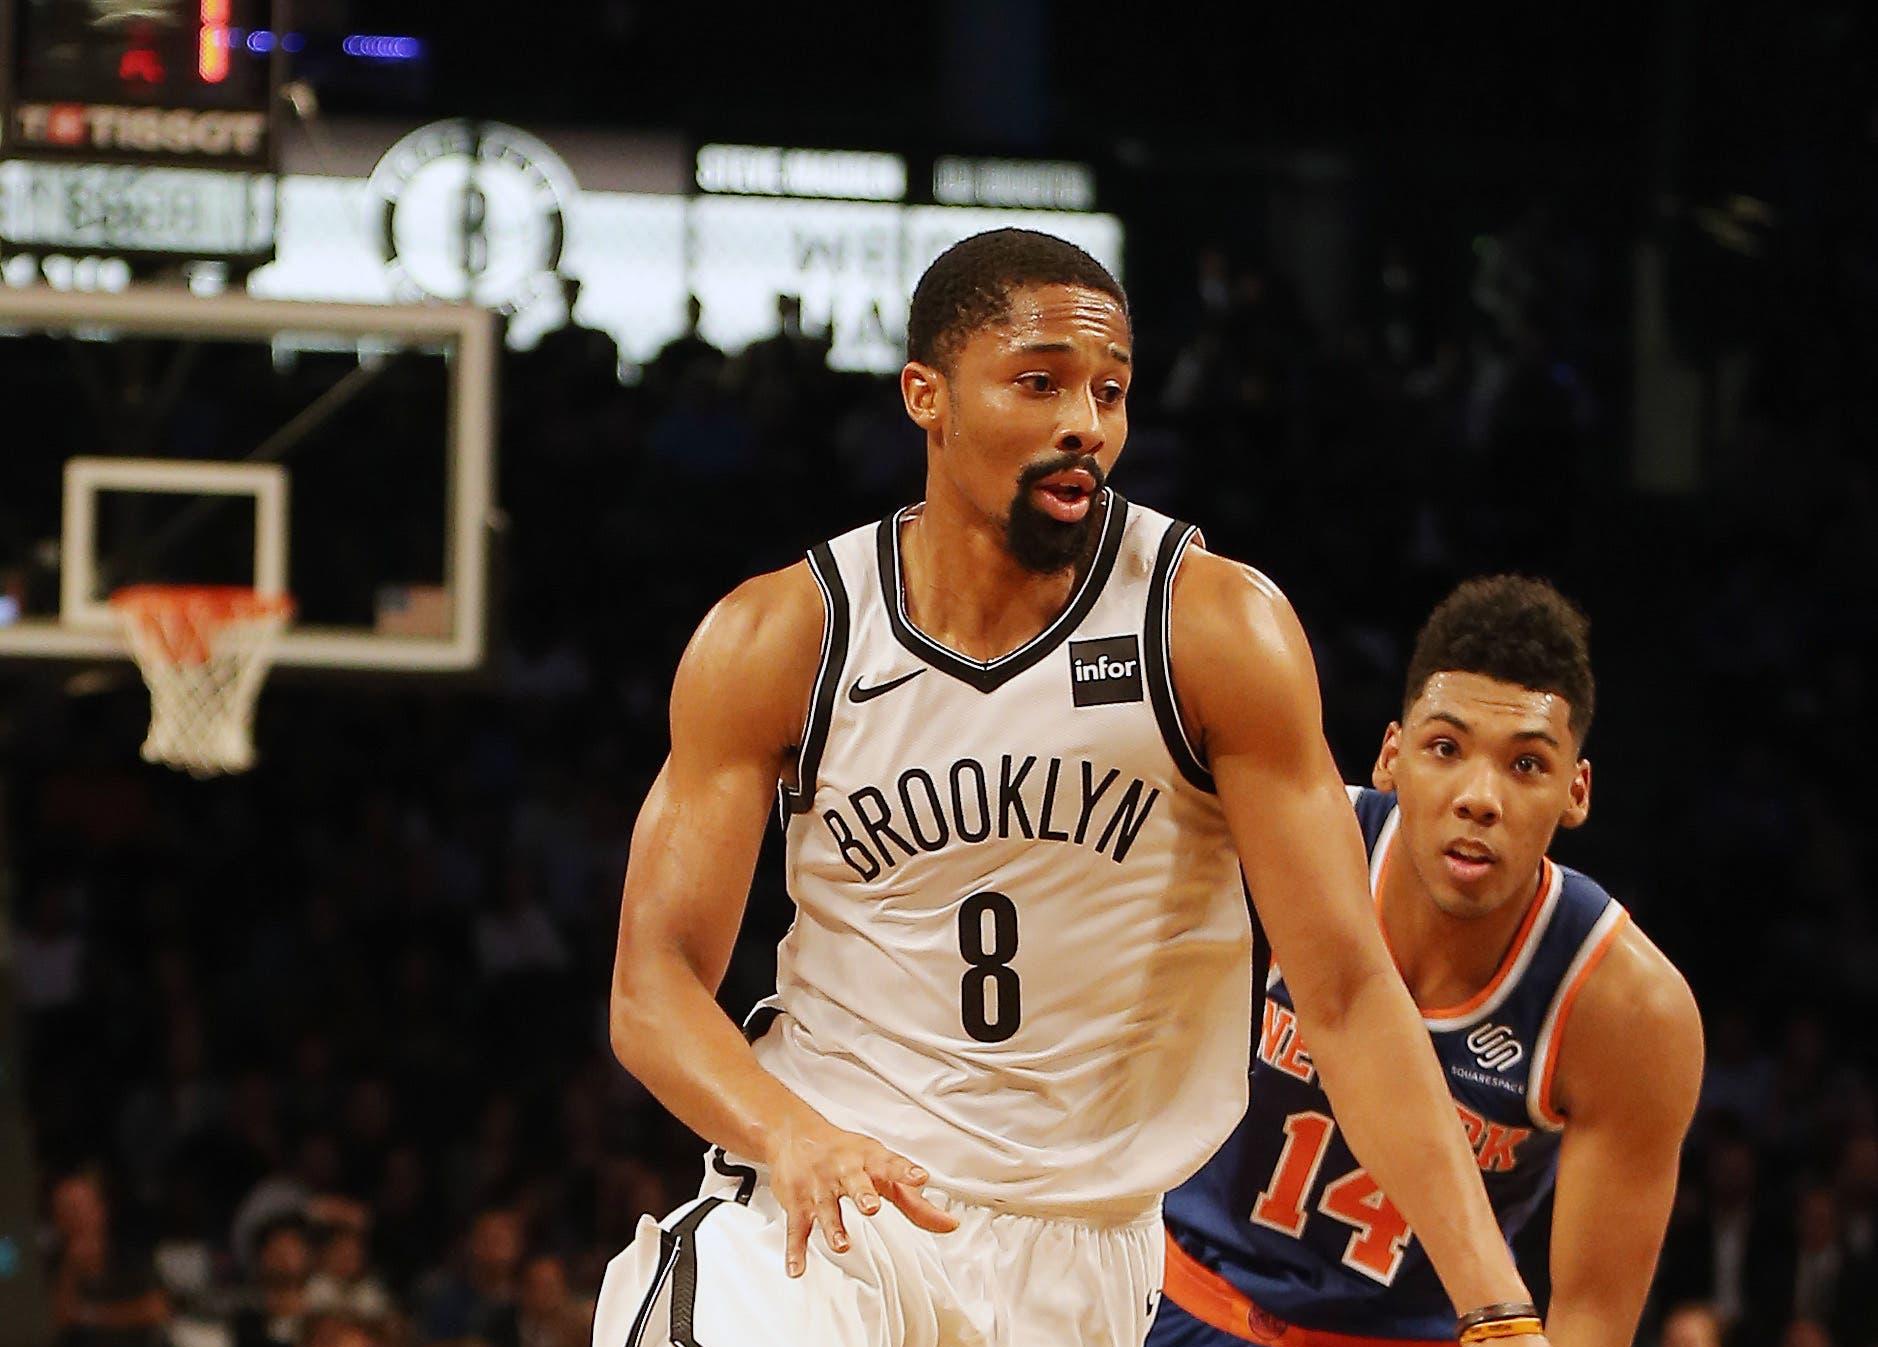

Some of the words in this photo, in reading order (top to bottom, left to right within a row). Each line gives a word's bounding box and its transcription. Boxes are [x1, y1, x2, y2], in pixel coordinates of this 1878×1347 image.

[1074, 655, 1137, 682] infor
[822, 754, 1160, 883] BROOKLYN
[957, 890, 1022, 1044] 8
[1257, 998, 1314, 1084] NE
[1450, 1064, 1526, 1096] SQUARESPACE
[1250, 1110, 1413, 1288] 14
